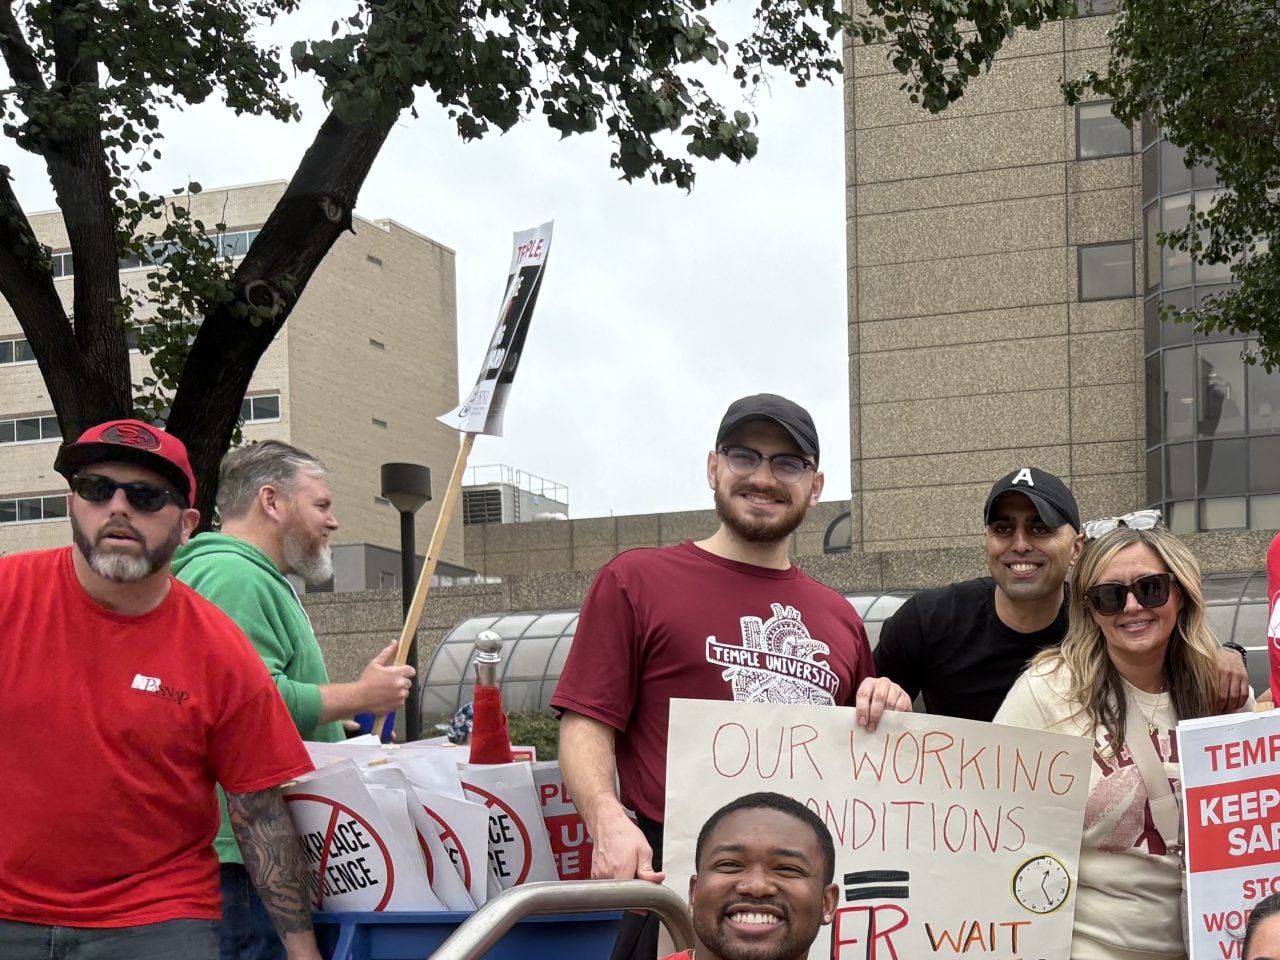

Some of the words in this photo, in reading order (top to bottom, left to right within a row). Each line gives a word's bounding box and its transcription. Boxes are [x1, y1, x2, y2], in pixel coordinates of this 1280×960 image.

[1011, 467, 1035, 487] A
[712, 646, 761, 667] TEMPLE
[766, 655, 838, 691] UNIVERSITY
[145, 678, 191, 706] PASNP
[712, 722, 823, 780] OUR
[849, 730, 1075, 796] WORKING
[806, 797, 1026, 852] NDITIONS
[1200, 788, 1280, 827] KEEP
[561, 823, 590, 849] U
[924, 921, 1032, 956] WAIT
